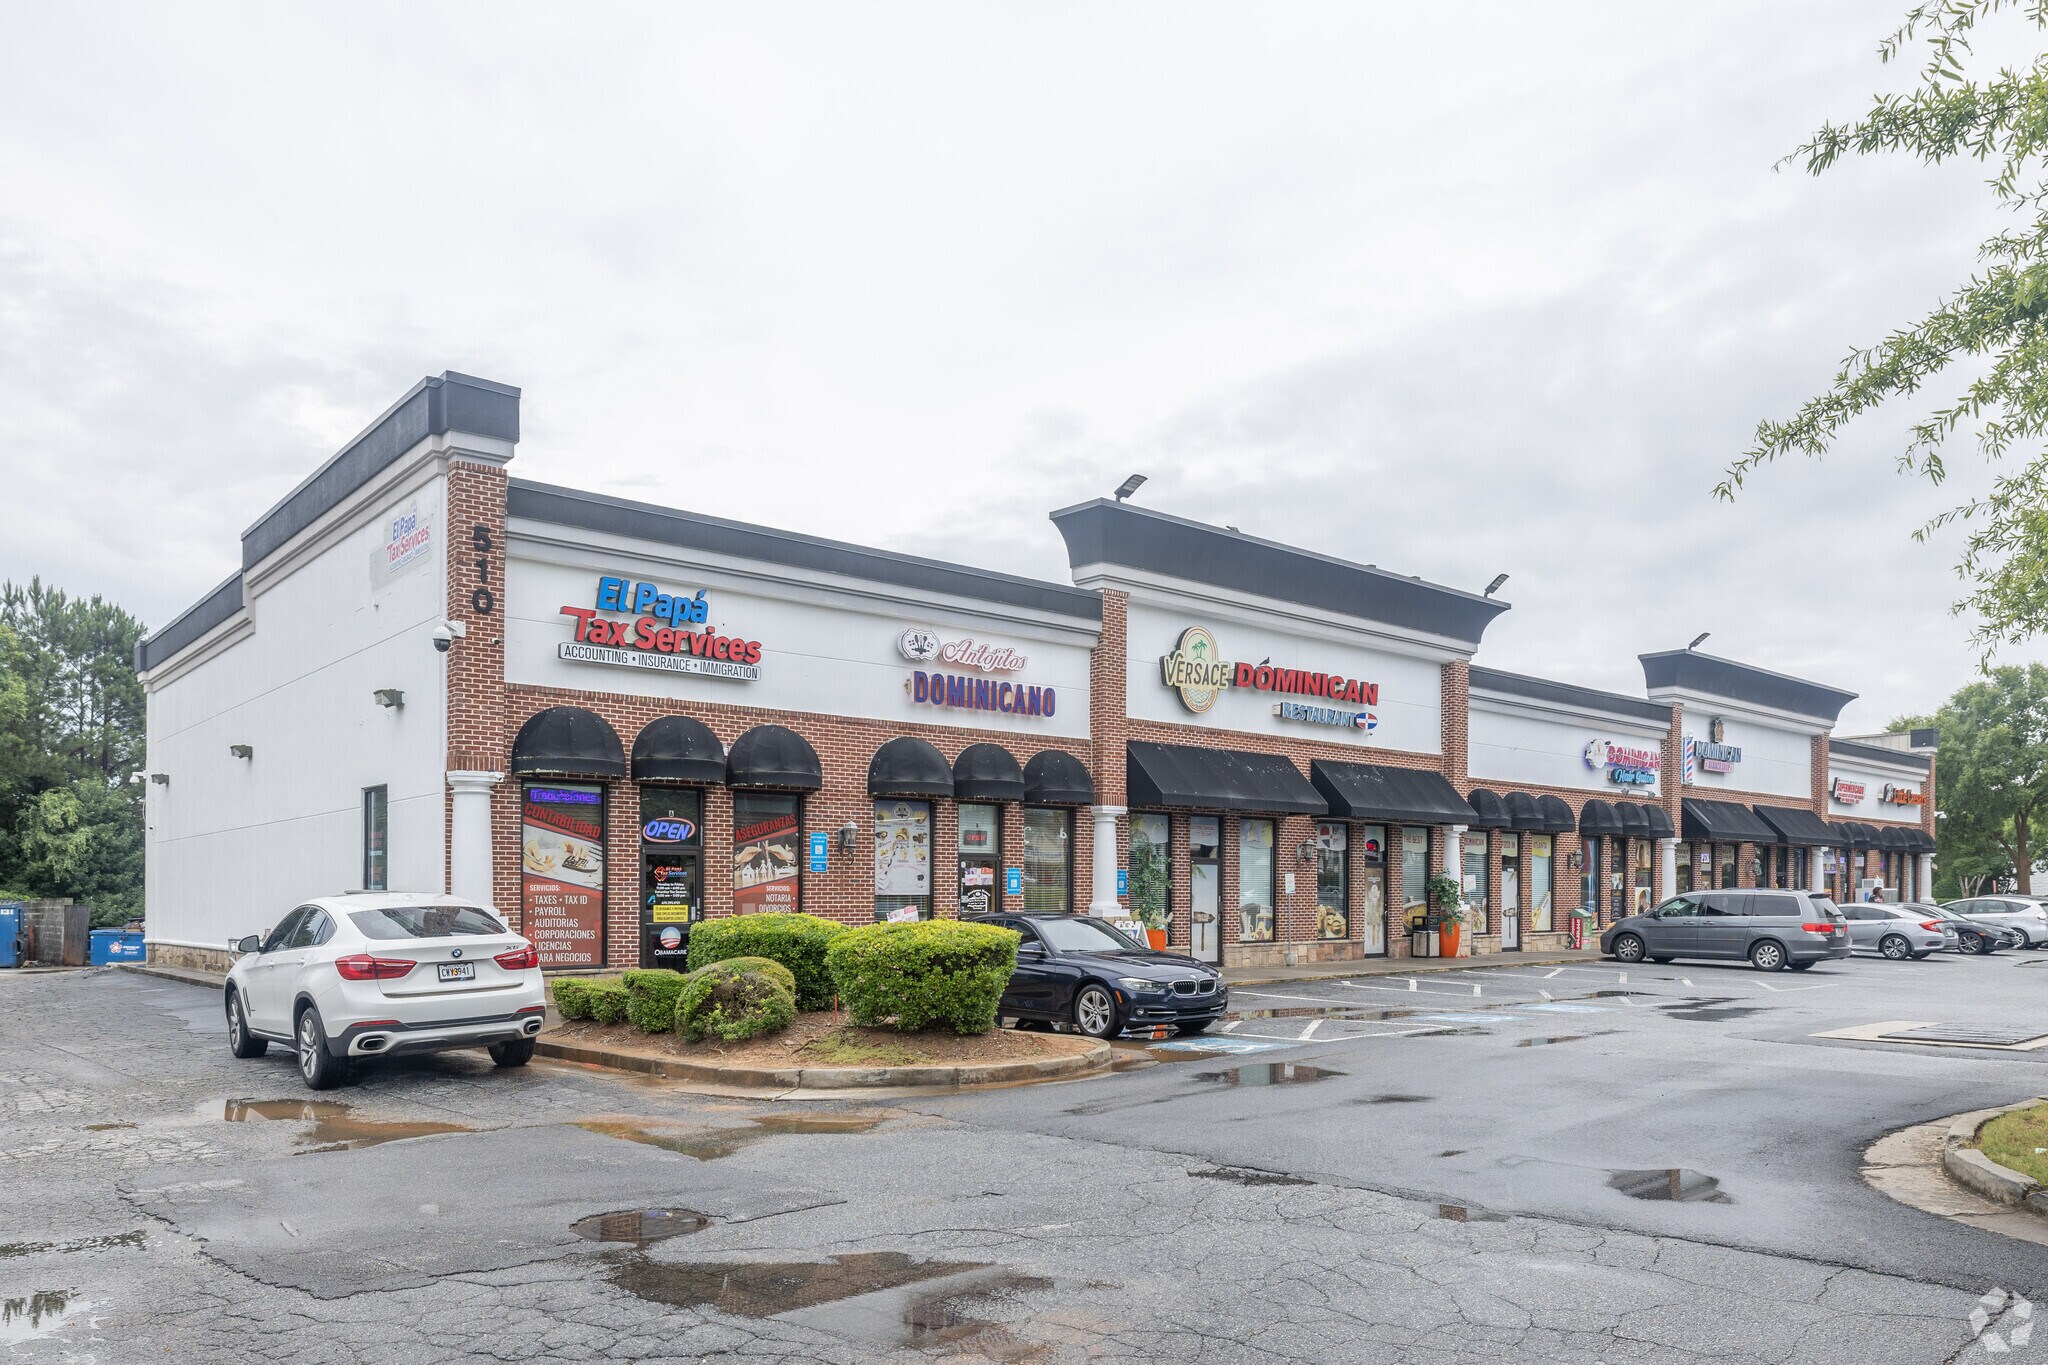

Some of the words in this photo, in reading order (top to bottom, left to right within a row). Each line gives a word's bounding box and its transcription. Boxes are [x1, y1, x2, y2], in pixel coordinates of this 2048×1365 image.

[386, 543, 400, 562] Tax
[400, 524, 429, 556] Services
[597, 576, 630, 613] El
[633, 582, 709, 628] Papá
[560, 606, 630, 647] Tax
[634, 617, 763, 664] Services
[564, 645, 628, 663] ACCOUNTING
[638, 654, 691, 671] INSURANCE
[700, 661, 758, 679] IMMIGRATION
[942, 639, 1028, 671] Antojitos
[1165, 652, 1229, 687] VERSACE
[913, 671, 1056, 717] DOMINICANO
[1234, 661, 1378, 706] DOMINICAN
[1281, 702, 1356, 727] RESTAURANT
[1607, 746, 1661, 768] DOMINICAN
[1694, 741, 1741, 763] DOMINICAN
[1615, 769, 1635, 783] Hair
[1635, 770, 1655, 784] Salon
[525, 803, 600, 838] CONTABILIDAD
[646, 820, 690, 840] OPEN
[735, 814, 796, 842] ASEGURANZAS
[529, 884, 560, 892] SERVICIOS:
[765, 894, 791, 902] NOTARIA
[535, 895, 557, 904] TAXES
[564, 895, 579, 904] TAX
[580, 895, 588, 904] ID
[758, 904, 791, 913] DIVORCIOS
[534, 907, 567, 916] PAYROLL
[534, 918, 579, 928] AUDITORIAS
[534, 930, 596, 939] CORPORACIONES
[534, 941, 572, 951] LICENCIAS
[555, 952, 592, 962] NEGOCIOS
